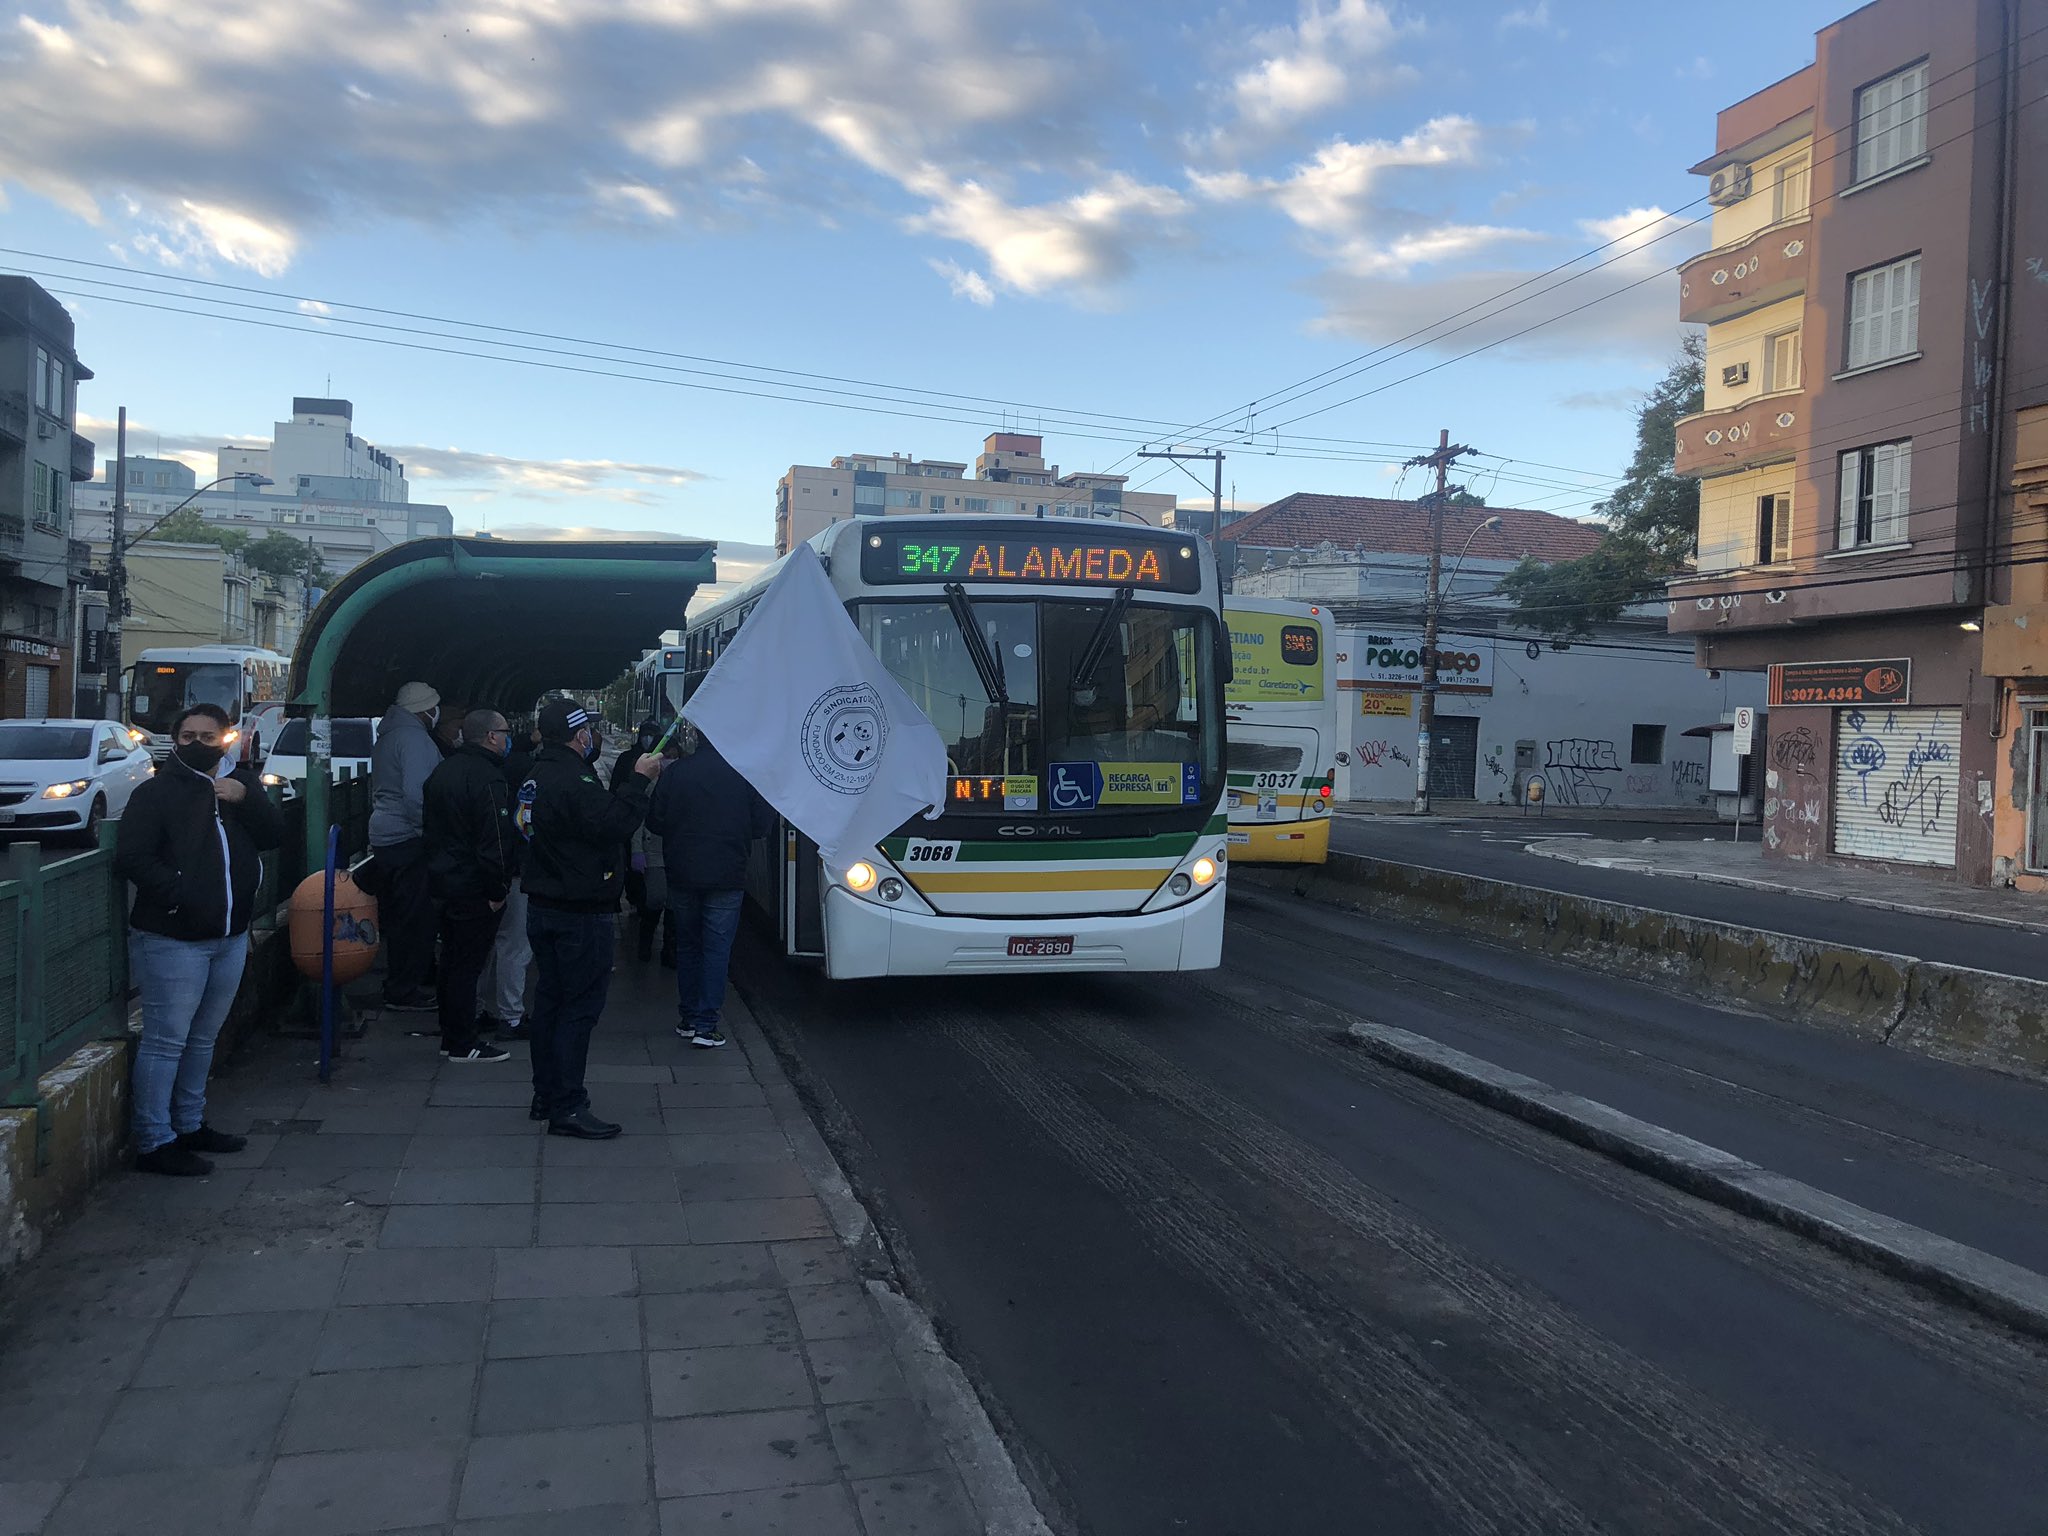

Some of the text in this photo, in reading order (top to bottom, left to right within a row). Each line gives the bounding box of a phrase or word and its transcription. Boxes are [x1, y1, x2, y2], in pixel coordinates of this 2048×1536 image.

[902, 544, 1161, 581] 347 ALAMEDA
[1368, 635, 1393, 646] BRICK
[1366, 648, 1419, 669] POKO
[1258, 680, 1299, 690] Claretiano
[1791, 687, 1863, 701] 3072.4342
[823, 695, 868, 716] SINDICATO
[812, 725, 873, 784] FUNDADO EM 23-12-1912
[1108, 773, 1151, 783] RECARGA
[1257, 773, 1298, 789] 3037
[1108, 783, 1152, 792] EXPRESSA
[1157, 781, 1169, 792] tri
[909, 846, 954, 862] 3068
[1011, 943, 1070, 955] IQC-2890
